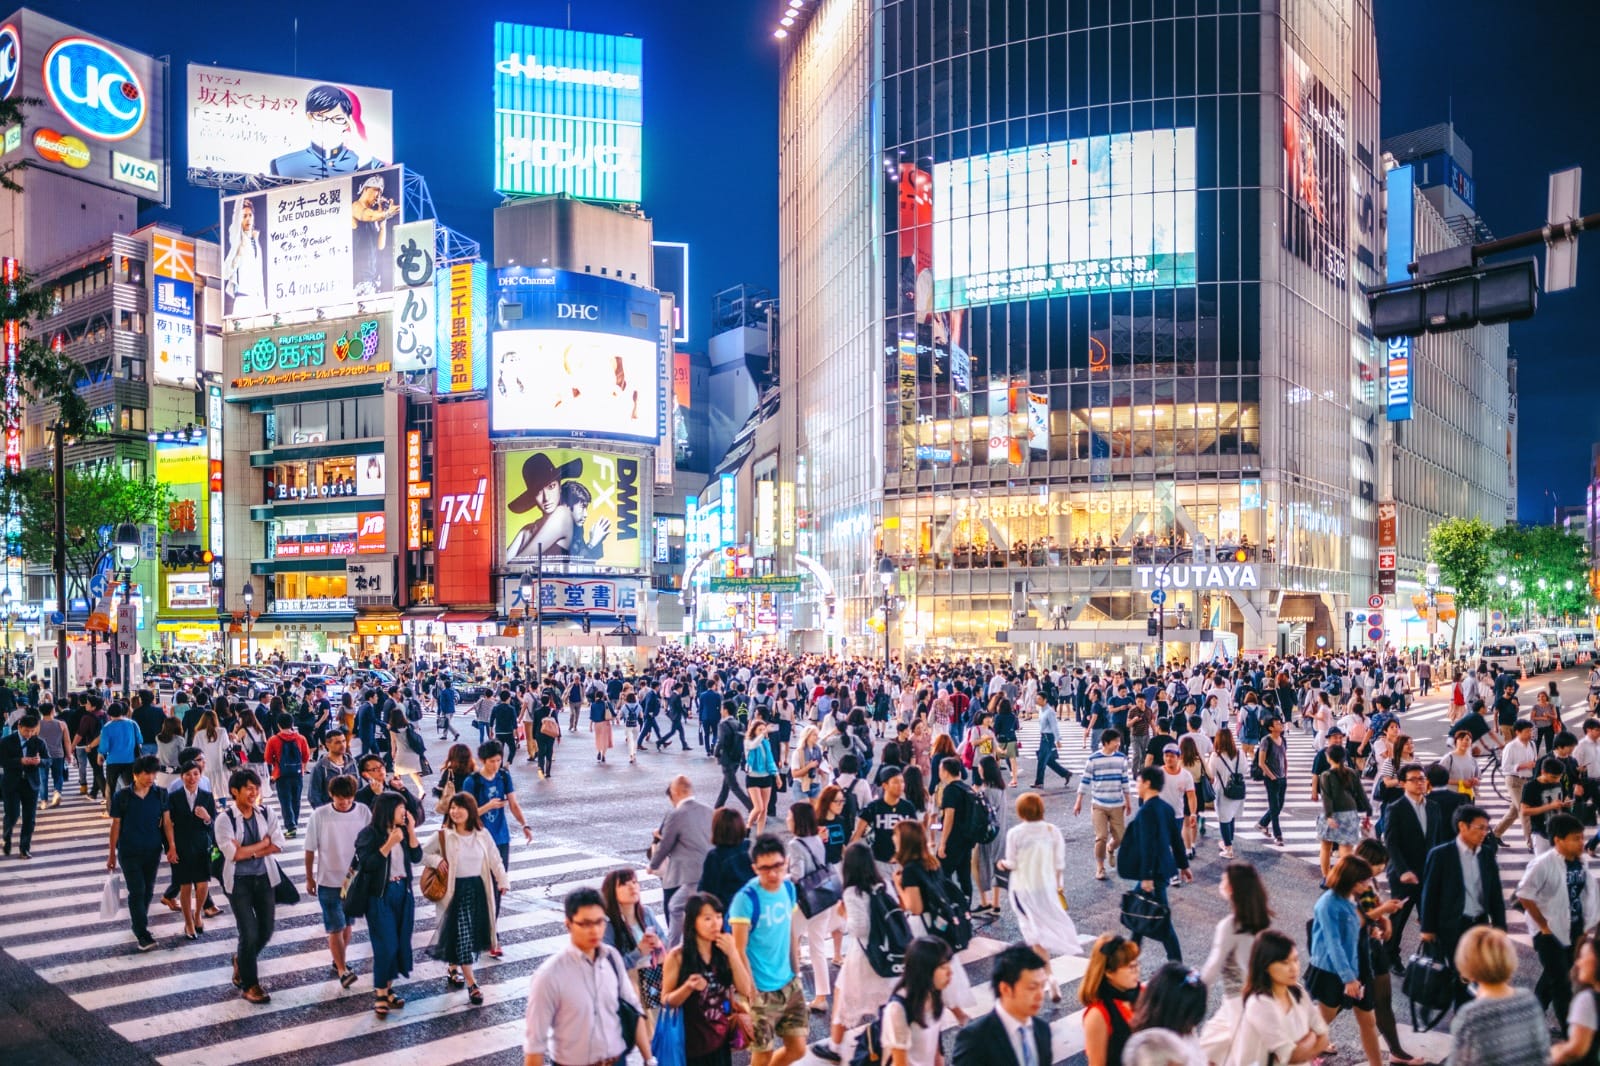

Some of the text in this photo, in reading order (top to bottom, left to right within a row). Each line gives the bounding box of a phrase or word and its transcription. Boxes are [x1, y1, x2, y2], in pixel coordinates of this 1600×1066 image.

[35, 137, 91, 162] MasterCard
[119, 161, 157, 184] VISA
[277, 188, 341, 215] タッキー&翼
[278, 205, 341, 224] LIVE DVD&Blu-ray
[276, 280, 297, 299] 5.4
[498, 276, 556, 286] DHC Channel
[396, 238, 433, 365] もんじゃ
[557, 303, 599, 321] DHC
[156, 318, 193, 337] 夜11時
[450, 268, 468, 385] 三千里薬品
[279, 343, 325, 369] 西村
[278, 482, 353, 500] Euphoria
[592, 454, 616, 512] FX
[617, 458, 638, 542] DMM
[955, 496, 1163, 522] STARBUCKS COFFEE
[1137, 565, 1257, 588] TSUTAYA
[511, 583, 638, 609] 大盛堂書店
